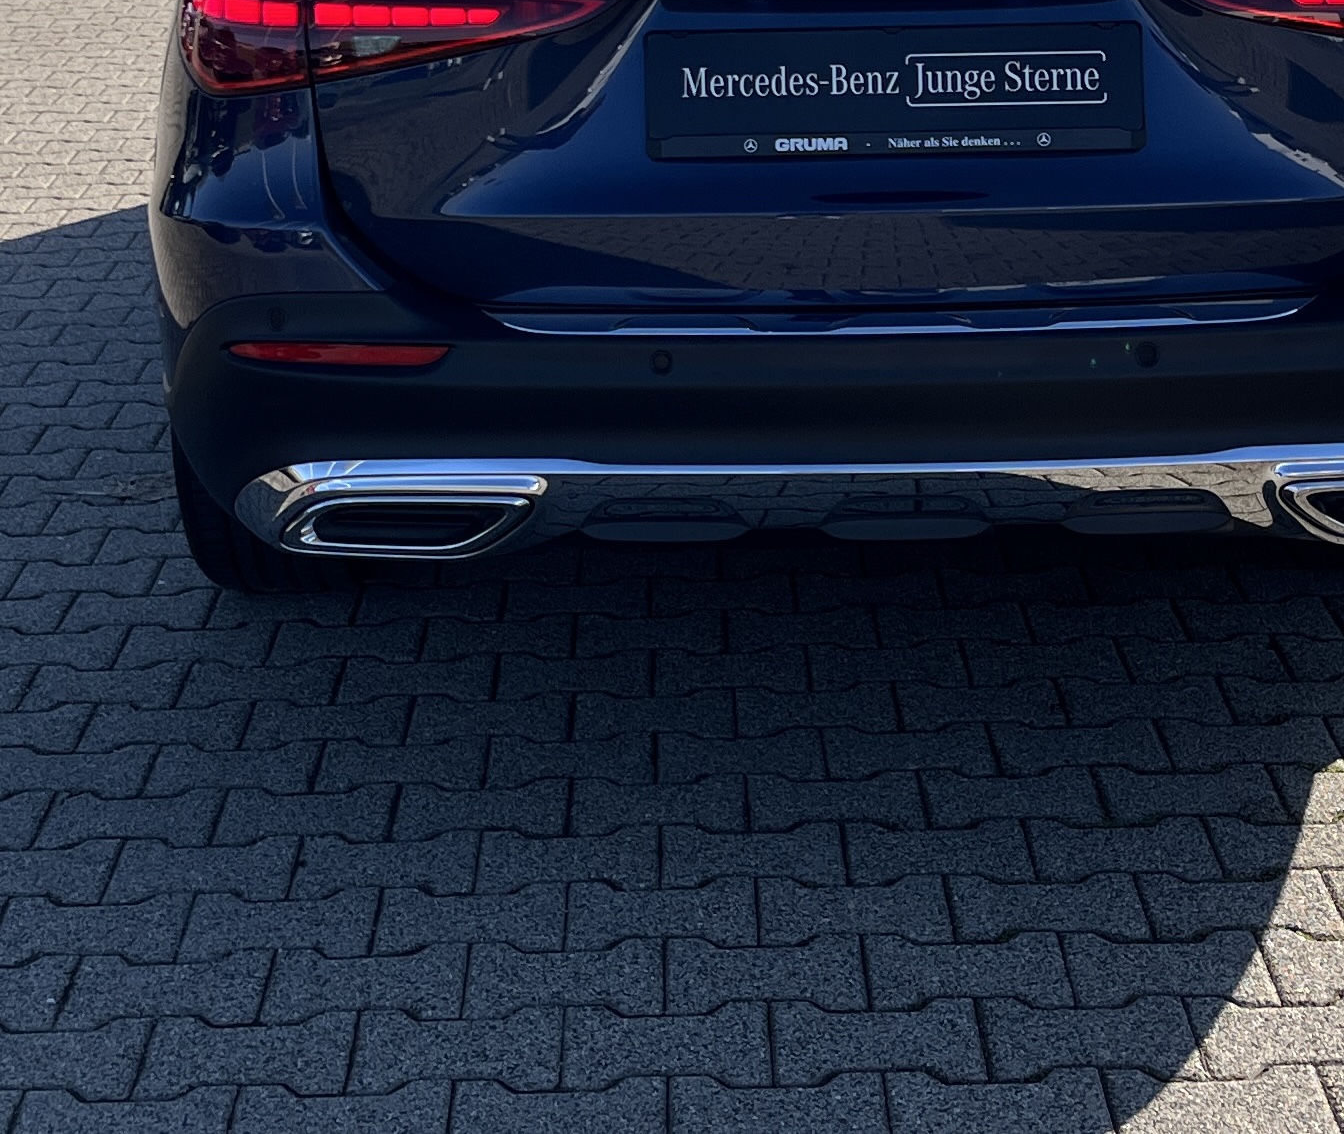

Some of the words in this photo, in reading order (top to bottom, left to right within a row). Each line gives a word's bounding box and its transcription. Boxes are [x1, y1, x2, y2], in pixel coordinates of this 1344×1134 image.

[681, 63, 901, 98] Mercedes-Benz
[914, 62, 996, 100] Junge
[1003, 60, 1101, 93] Sterne
[774, 137, 849, 153] GRUMA
[887, 137, 922, 150] Näher
[923, 136, 940, 149] als
[941, 136, 959, 148] Sie
[961, 135, 1002, 147] denken
